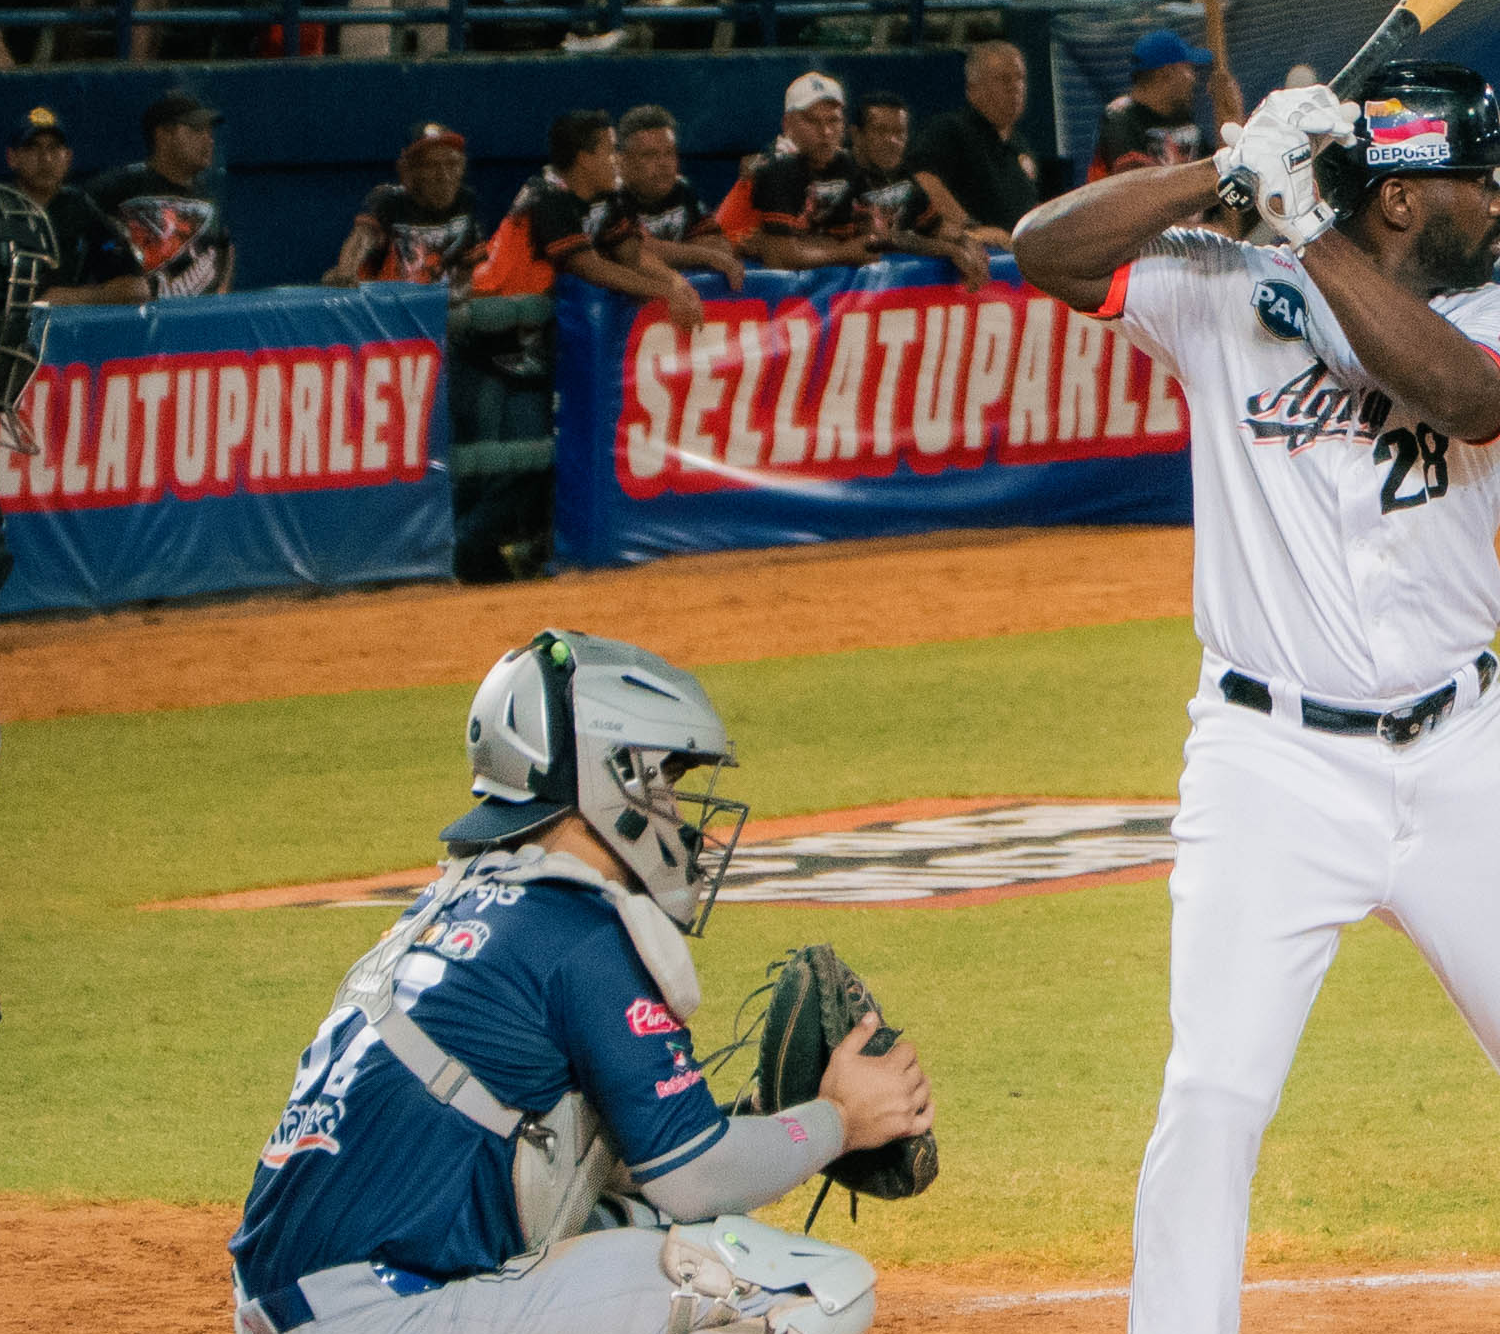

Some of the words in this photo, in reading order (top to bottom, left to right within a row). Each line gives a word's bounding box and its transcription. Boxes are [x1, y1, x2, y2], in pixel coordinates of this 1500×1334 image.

[1367, 145, 1449, 165] DEPORTE
[628, 298, 1183, 480] SELLATUPARLE
[1372, 422, 1450, 515] 28
